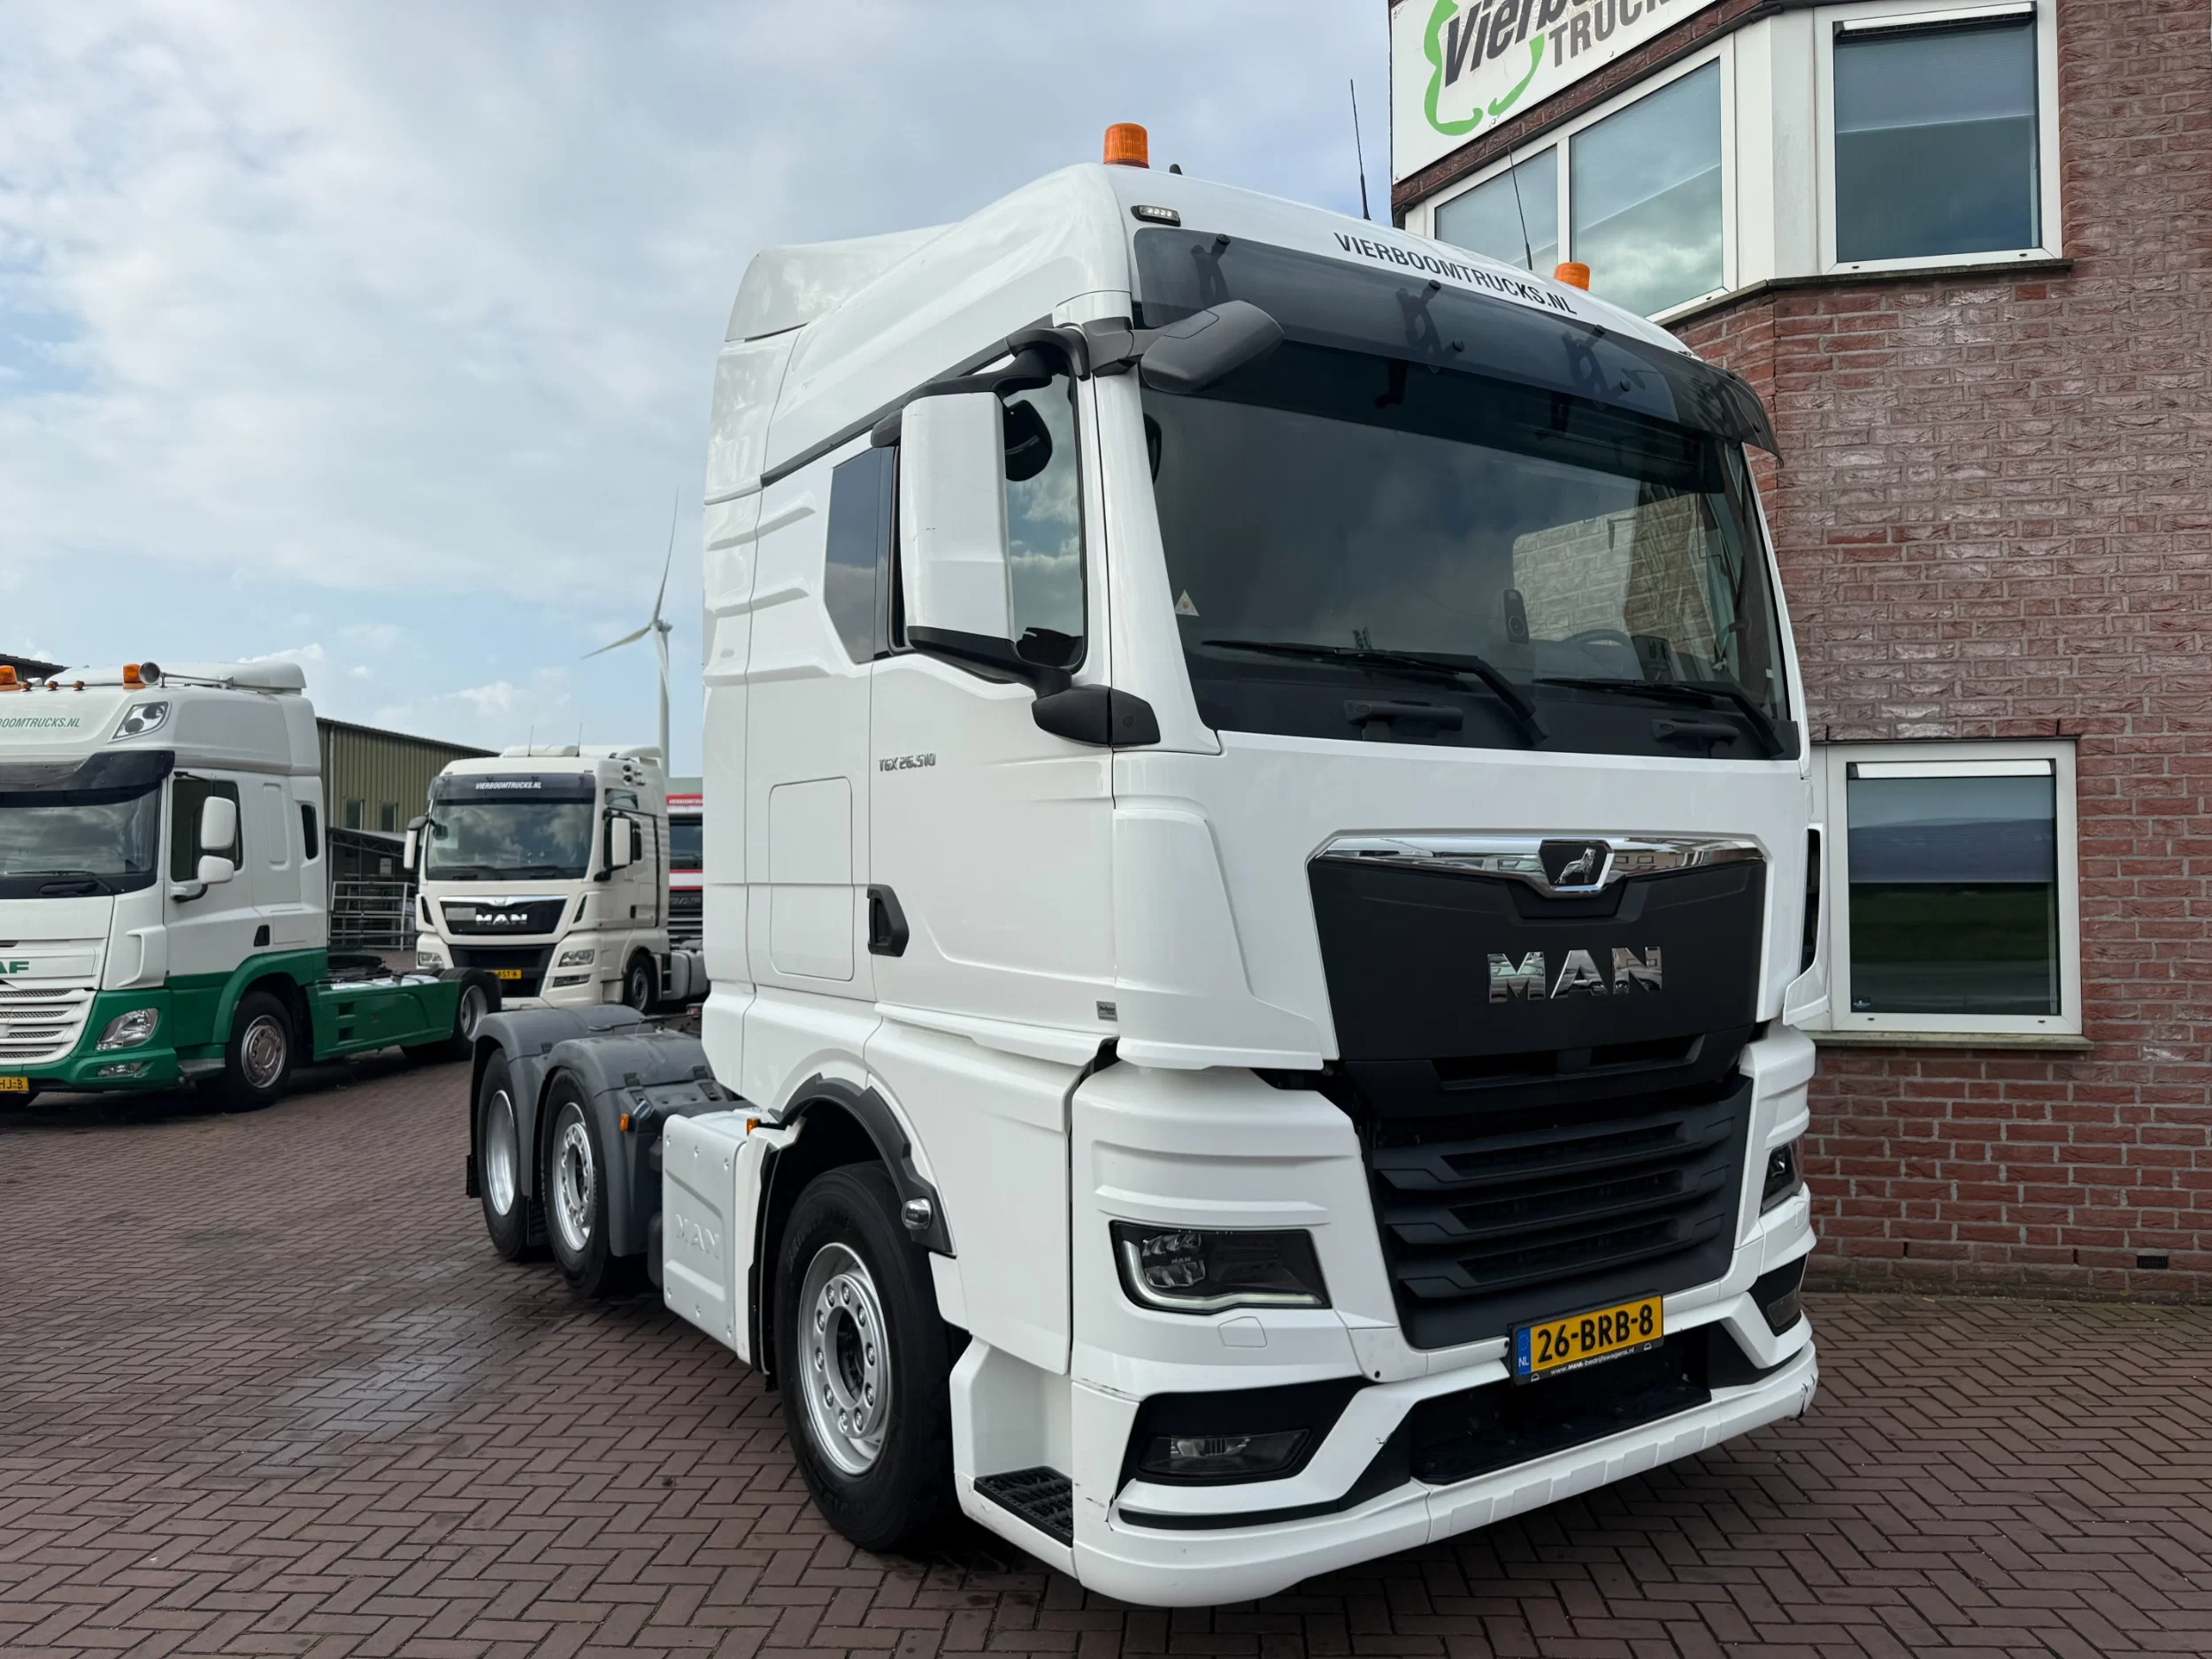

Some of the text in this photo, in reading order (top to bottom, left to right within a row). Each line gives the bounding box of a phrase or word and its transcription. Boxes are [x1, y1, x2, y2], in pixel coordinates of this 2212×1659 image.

[1333, 232, 1578, 315] VIERBOOMTRUCKS.NL
[879, 753, 937, 772] TGX 26.510
[475, 781, 542, 790] VIERBOOMTRUCKS.NL
[476, 914, 528, 926] MAN
[1487, 946, 1663, 1003] MAN
[1518, 1304, 1654, 1367] NL 26-BRB-8
